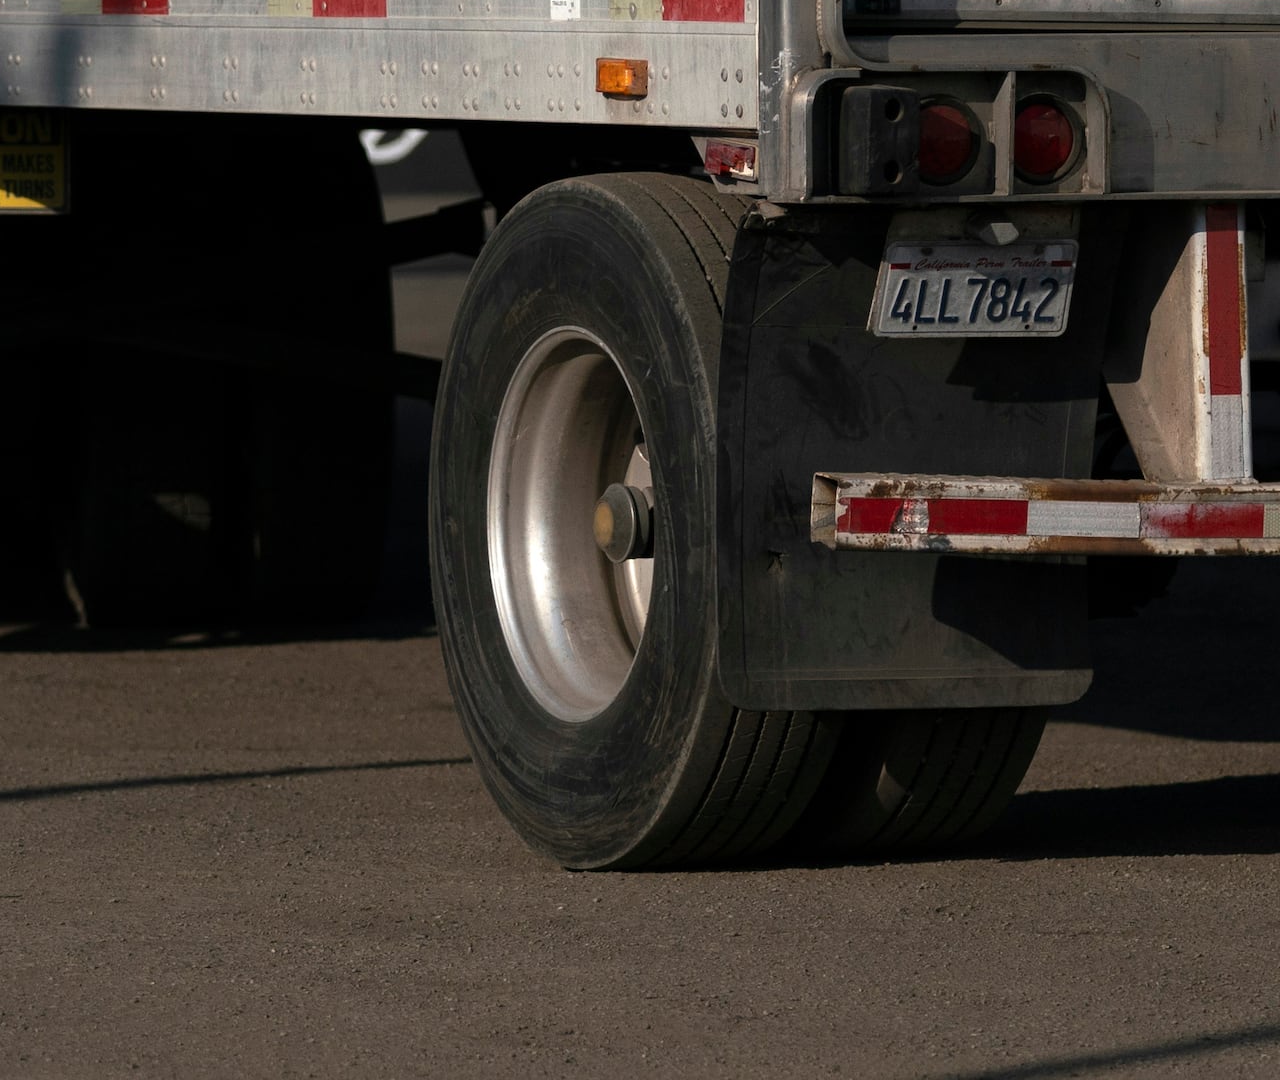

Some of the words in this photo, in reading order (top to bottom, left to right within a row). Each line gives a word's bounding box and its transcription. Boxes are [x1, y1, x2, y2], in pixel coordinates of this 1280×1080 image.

[3, 153, 55, 174] MAKES
[3, 179, 56, 200] TURNS
[914, 257, 971, 272] California
[975, 257, 1005, 269] Perm
[1011, 257, 1049, 268] Trailer
[889, 276, 1060, 325] 4LL7842
